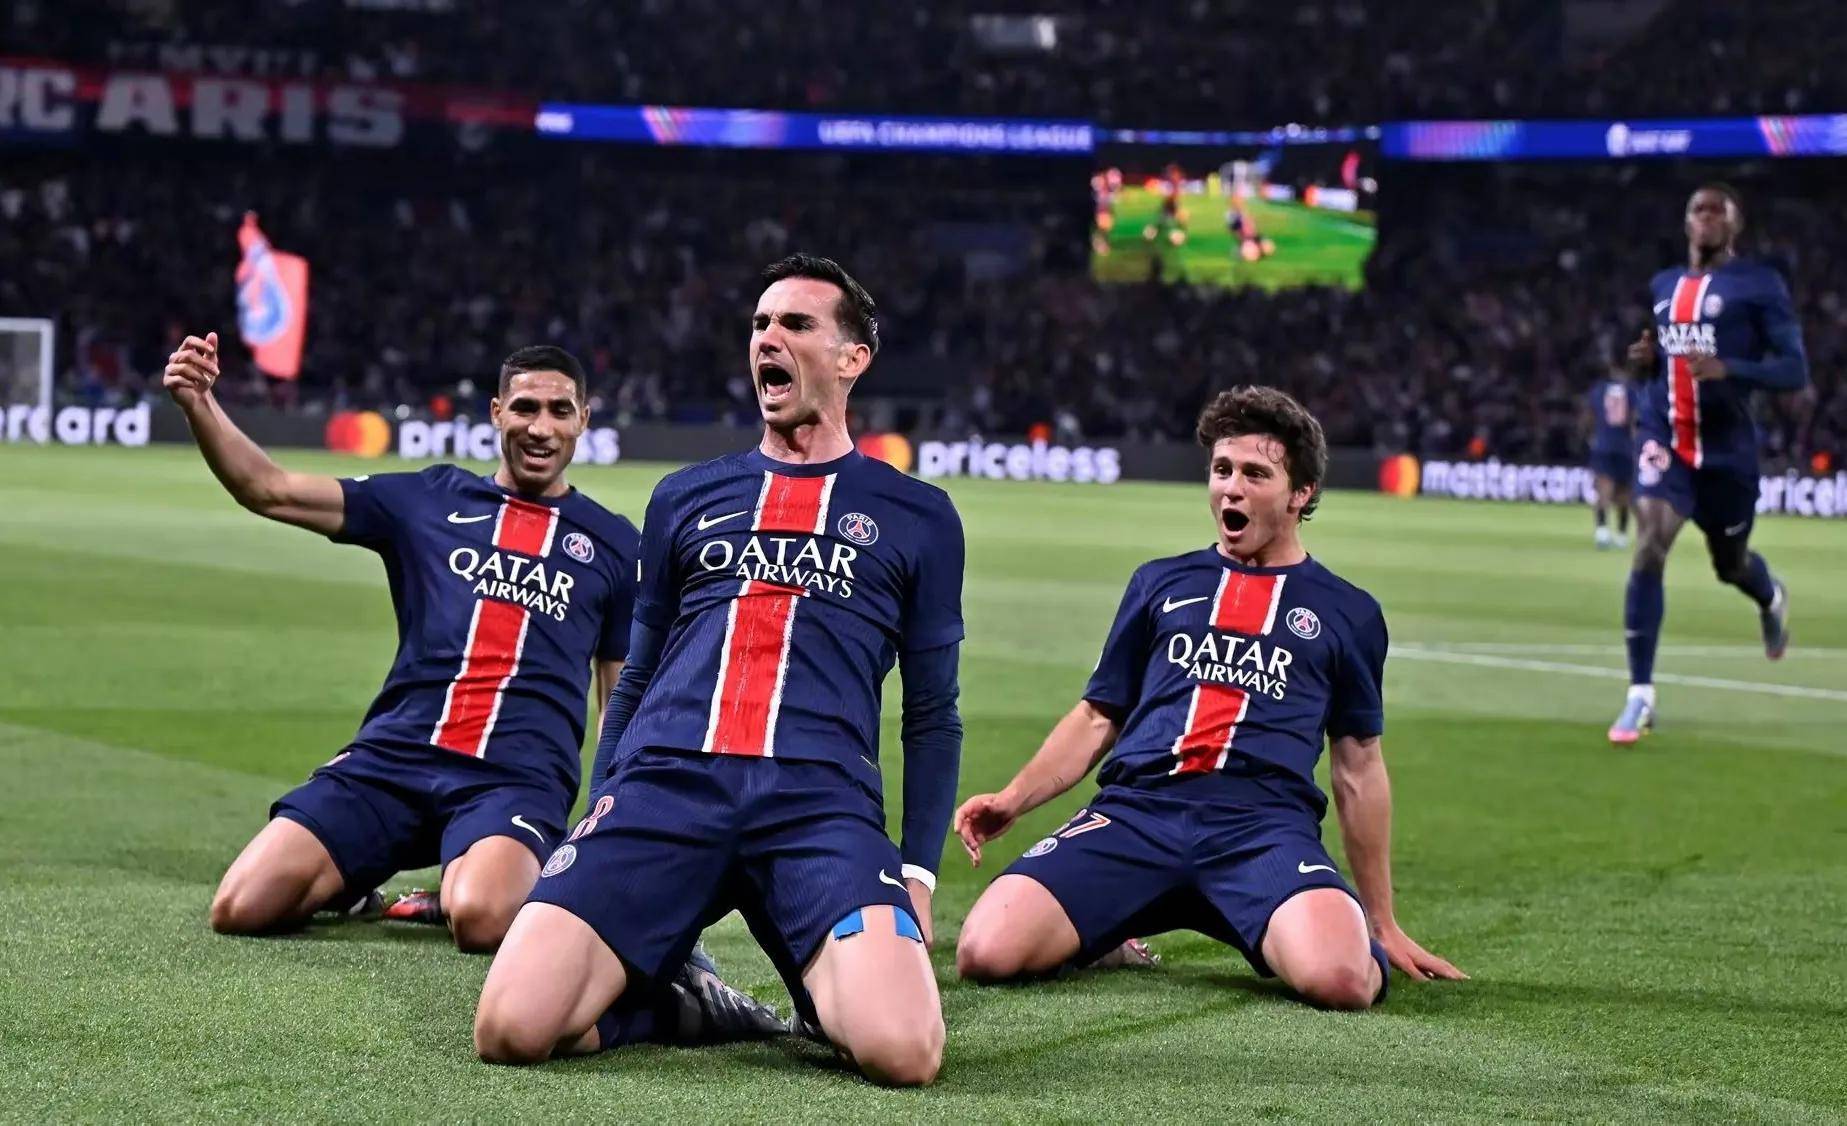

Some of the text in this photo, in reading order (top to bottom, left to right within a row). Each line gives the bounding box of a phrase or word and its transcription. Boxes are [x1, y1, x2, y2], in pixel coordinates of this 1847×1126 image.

[0, 401, 151, 446] rcard
[398, 414, 621, 465] pricss
[918, 434, 1121, 483] priceless
[448, 547, 575, 604] QATAR
[699, 535, 858, 579] QATAR
[735, 562, 854, 599] AIRWAYS
[472, 577, 568, 622] AIRWAYS
[1167, 632, 1293, 683] QATAR
[1186, 661, 1287, 701] AIRWAYS
[566, 794, 615, 843] 8
